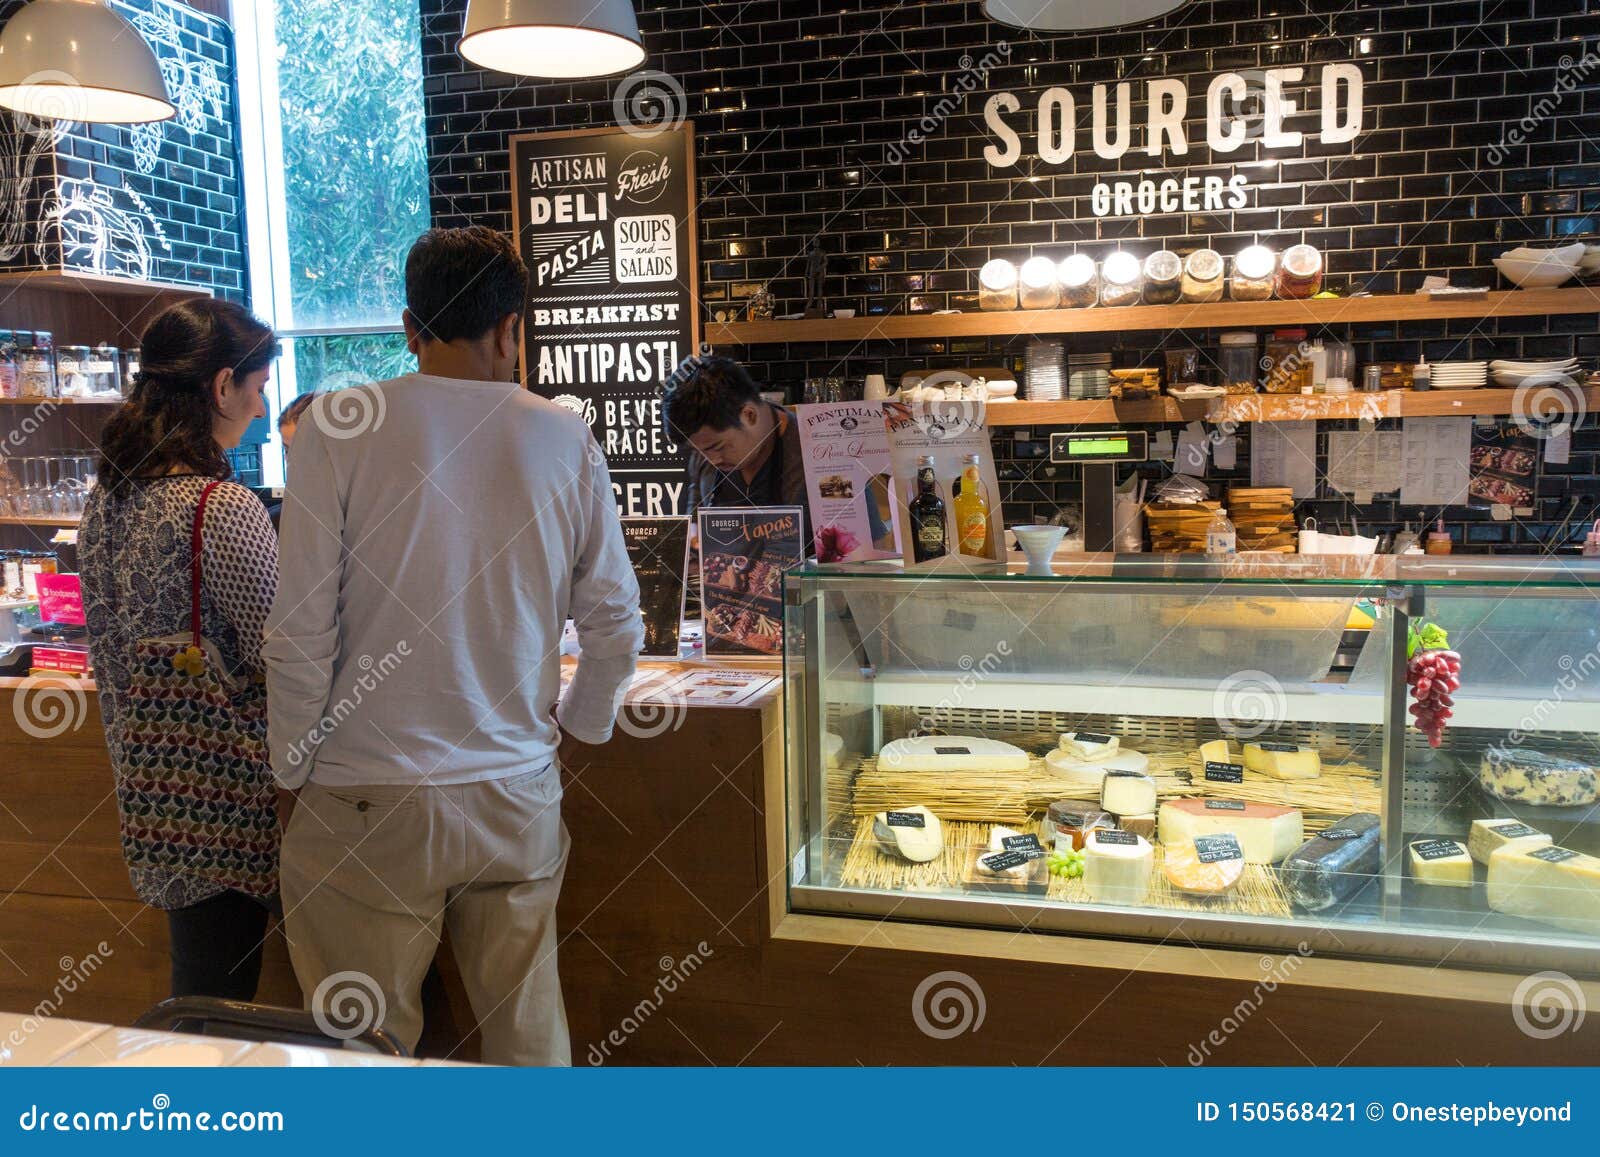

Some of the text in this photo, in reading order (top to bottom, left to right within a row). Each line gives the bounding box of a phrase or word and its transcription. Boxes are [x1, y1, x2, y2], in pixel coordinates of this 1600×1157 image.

[983, 63, 1363, 168] SOURCED
[531, 157, 606, 188] ARTISAN
[615, 156, 671, 200] Fresh
[531, 193, 607, 224] DELI
[1092, 174, 1247, 216] GROCERS
[620, 219, 671, 243] SOUPS
[538, 230, 605, 286] PASTA
[635, 243, 656, 254] and
[620, 256, 673, 278] SALADS
[534, 304, 679, 326] BREAKFAST
[538, 341, 678, 384] ANTIPASTI
[605, 400, 662, 426] BEVE
[807, 407, 883, 427] FENTIMAN
[625, 527, 658, 536] SOURCED
